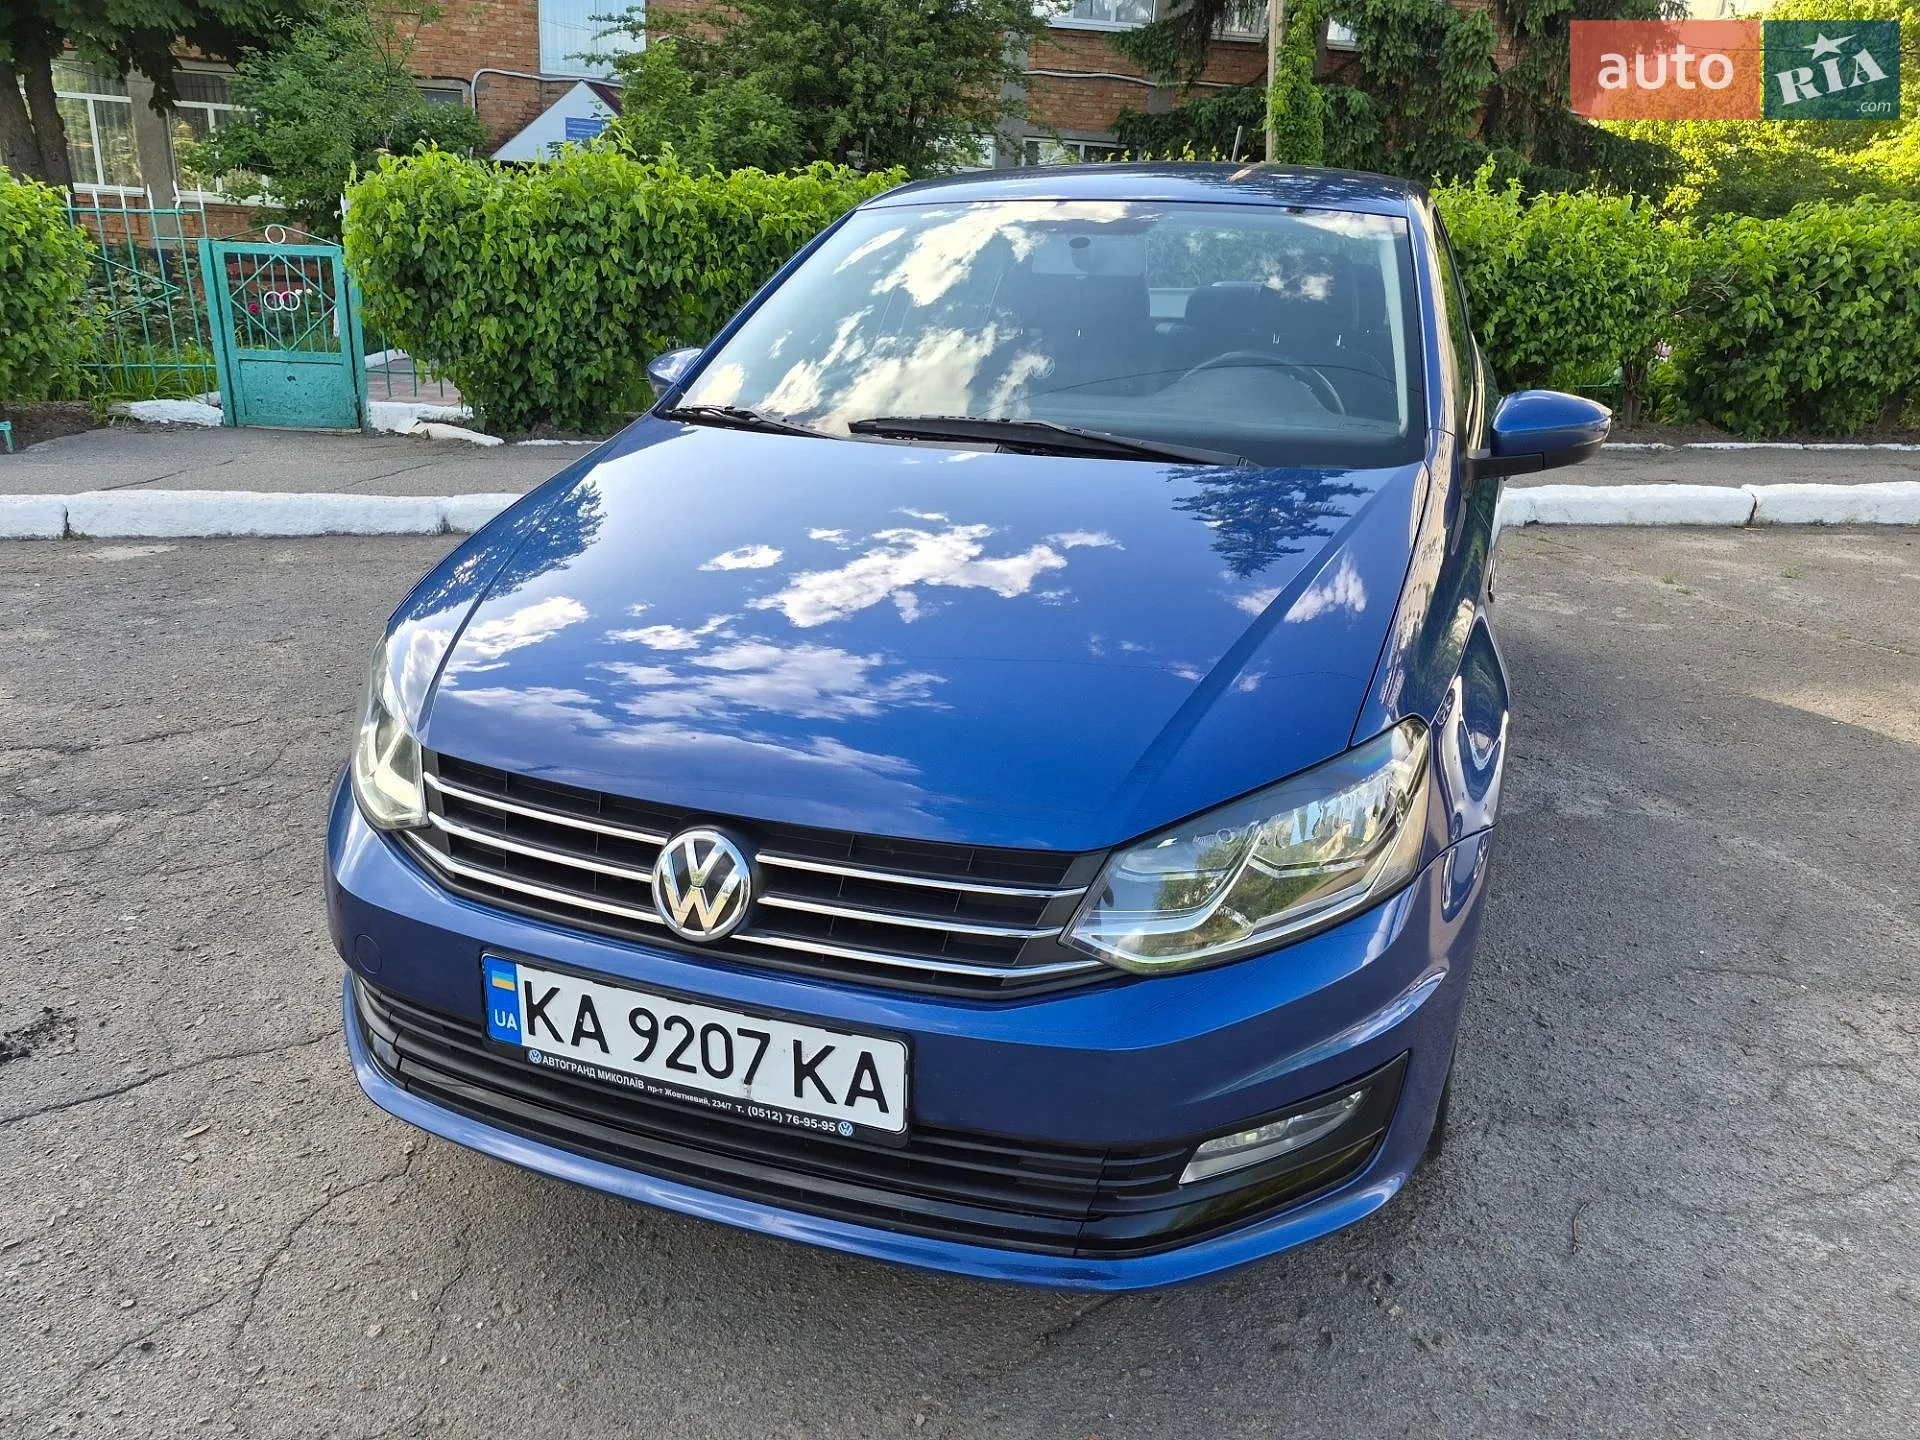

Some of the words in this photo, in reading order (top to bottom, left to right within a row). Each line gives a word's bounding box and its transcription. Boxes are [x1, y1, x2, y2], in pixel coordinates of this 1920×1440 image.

[494, 1009, 518, 1031] UA
[524, 981, 610, 1054] KA
[628, 1007, 770, 1086] 9207
[793, 1039, 890, 1114] KA
[542, 1055, 596, 1079] АВТОГРАНД
[597, 1069, 645, 1090] МИКОЛАЇВ
[647, 1084, 663, 1095] пр-т
[712, 1099, 732, 1111] 234/7
[747, 1105, 783, 1123] (0512)
[785, 1113, 836, 1133] 76-95-95
